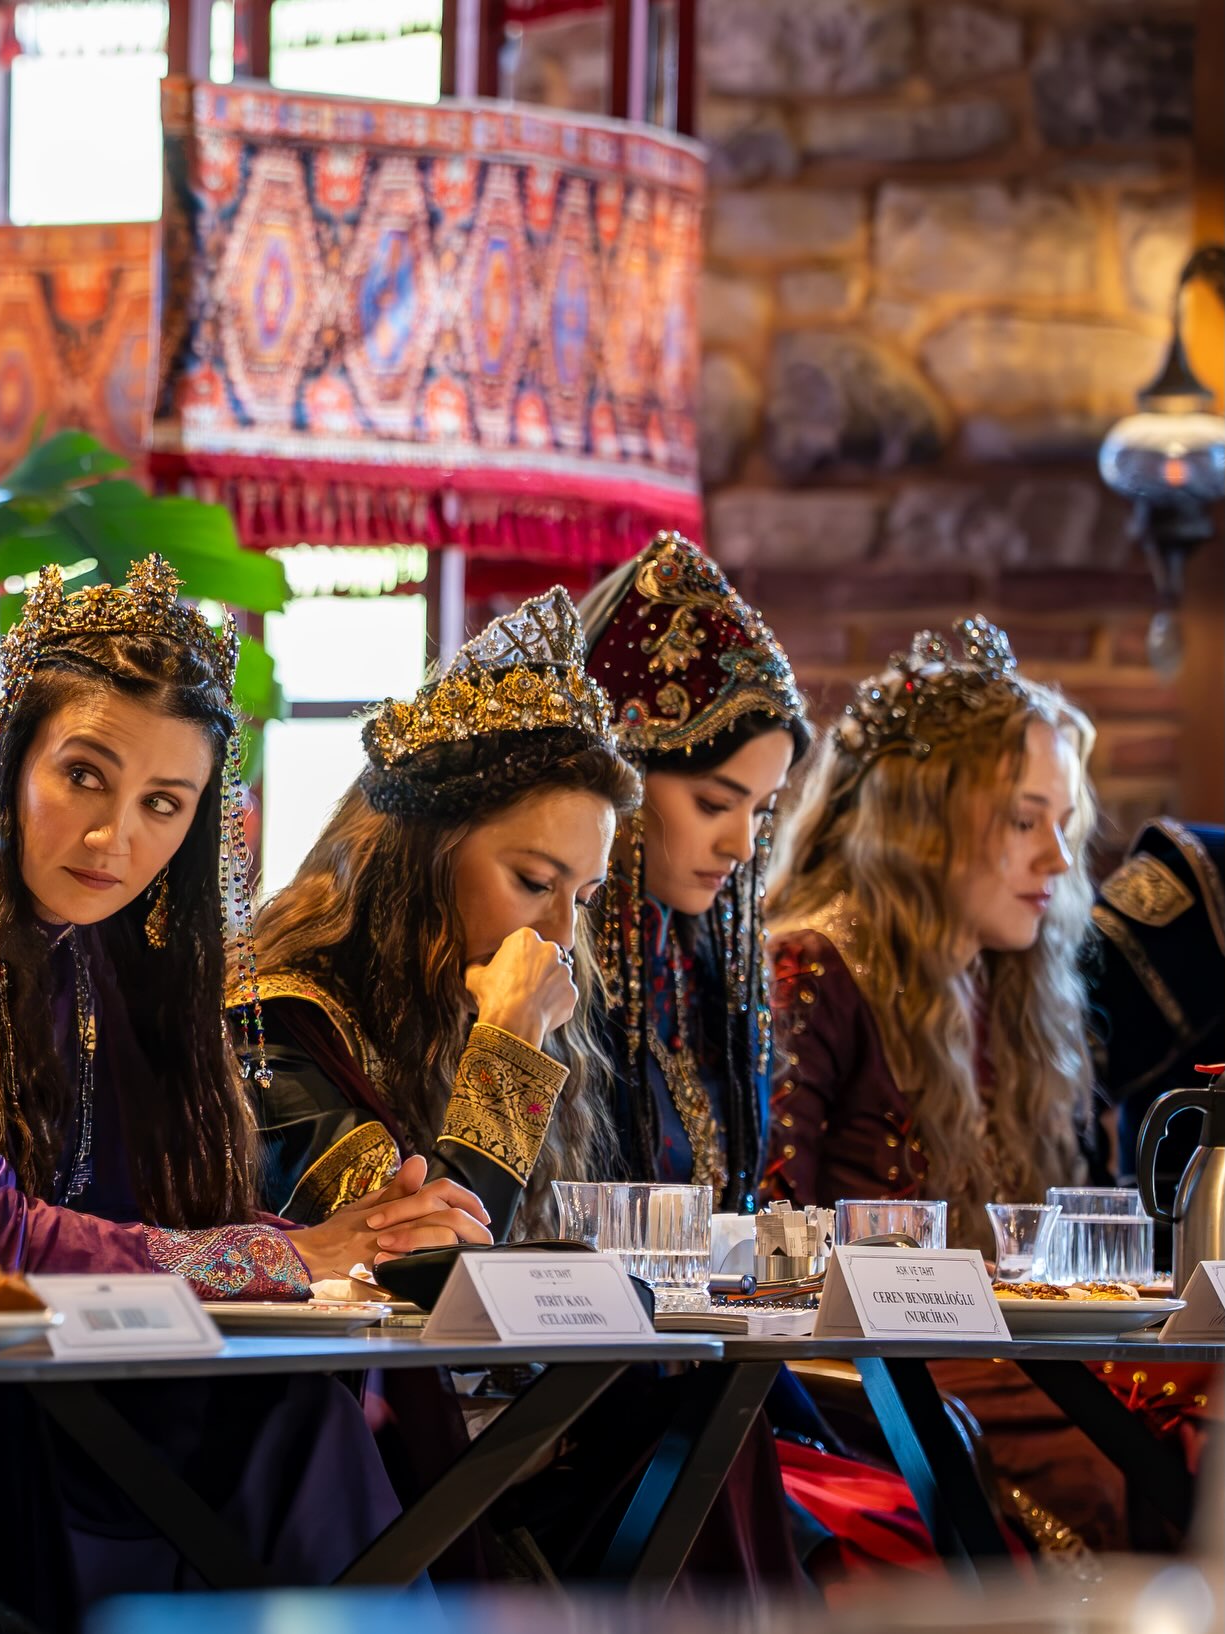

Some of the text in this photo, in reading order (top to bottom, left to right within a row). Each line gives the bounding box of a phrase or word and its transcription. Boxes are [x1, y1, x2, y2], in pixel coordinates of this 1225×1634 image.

[918, 1266, 935, 1276] TAHT
[872, 1290, 976, 1306] CEREN BENDERLİOĞLU
[904, 1309, 959, 1325] (NURCİHAN)
